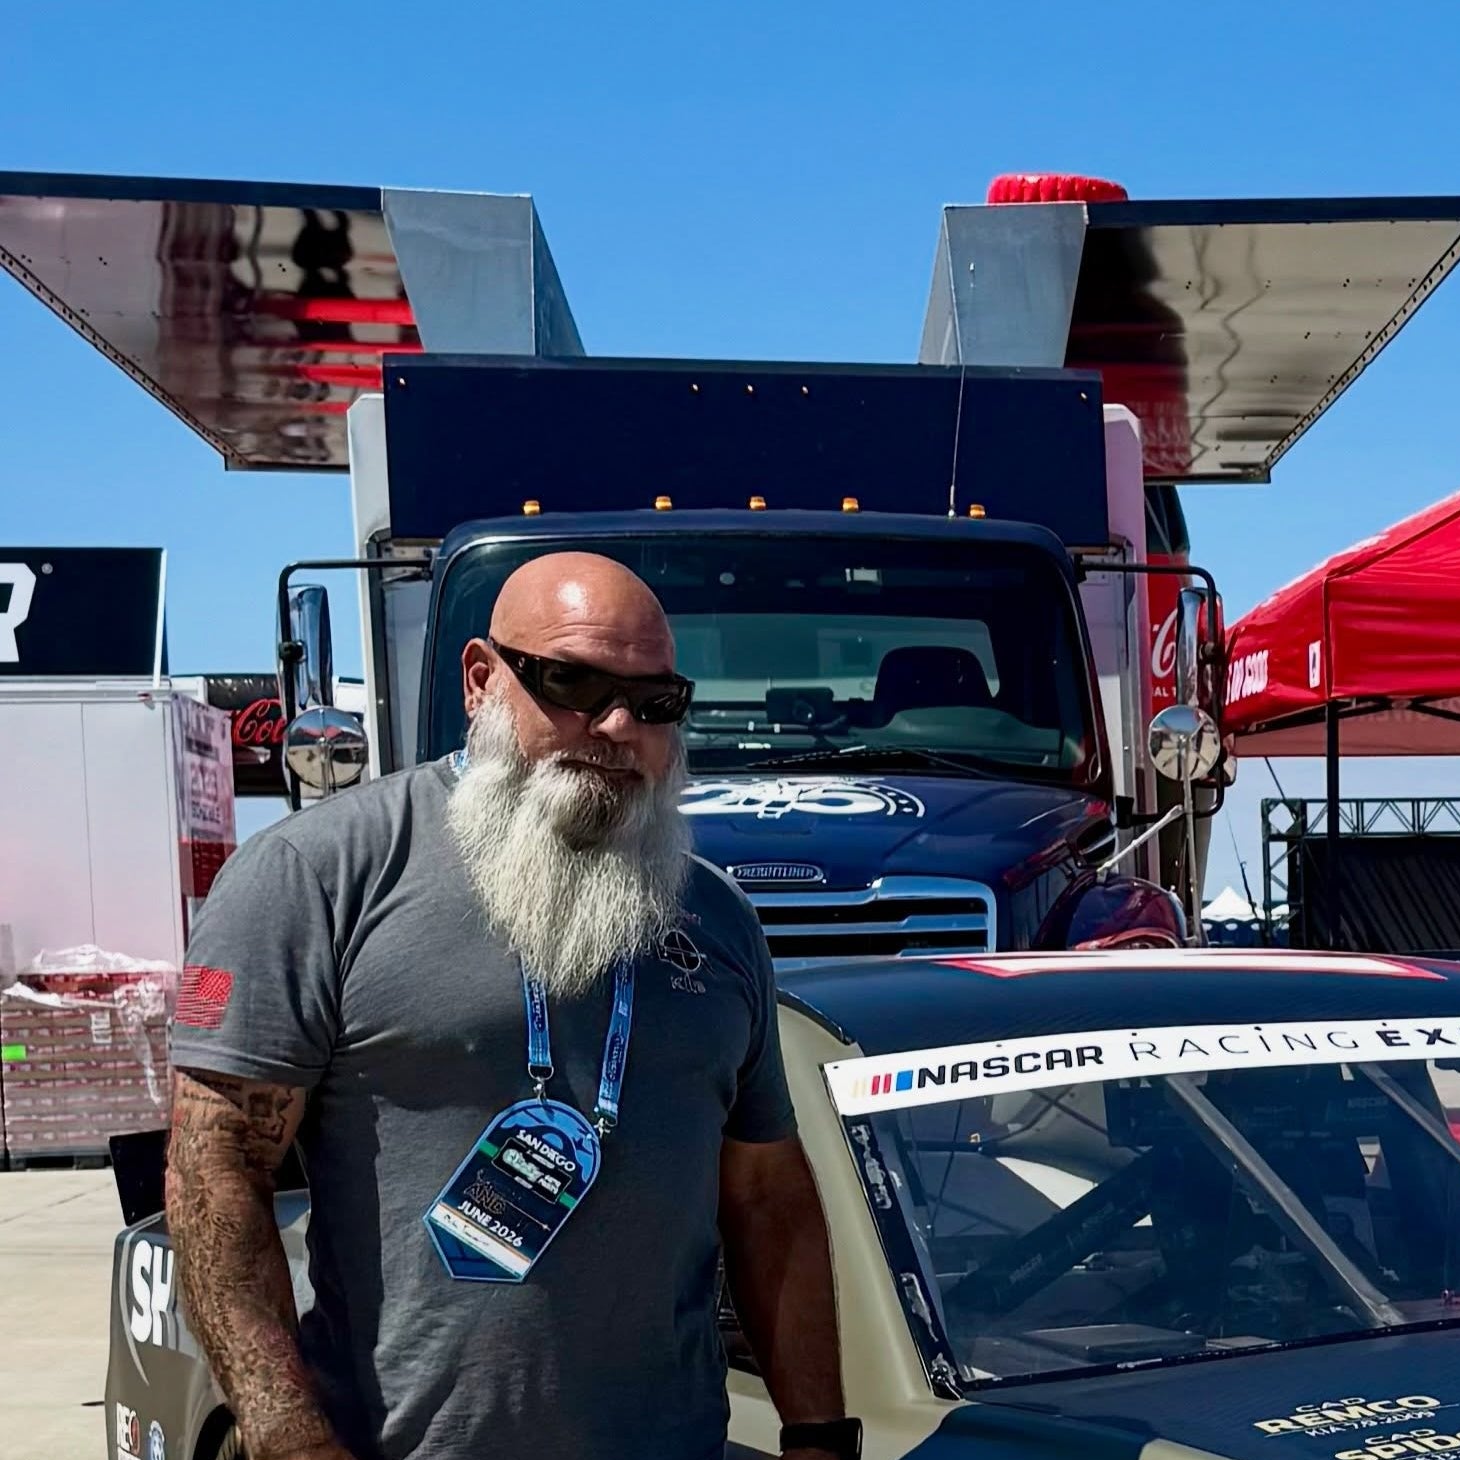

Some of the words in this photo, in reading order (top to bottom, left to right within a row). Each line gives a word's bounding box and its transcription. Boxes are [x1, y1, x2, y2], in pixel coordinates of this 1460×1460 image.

[917, 1045, 1103, 1089] NASCAR
[1128, 1029, 1359, 1061] RACING
[516, 1129, 543, 1150] SAN
[540, 1144, 576, 1172] DIEGO
[457, 1200, 492, 1228] JUNE
[488, 1219, 523, 1248] 2026
[131, 1240, 176, 1347] SH
[1253, 1395, 1441, 1434] REMCO
[1296, 1397, 1366, 1413] CAD
[1365, 1428, 1438, 1445] CAD
